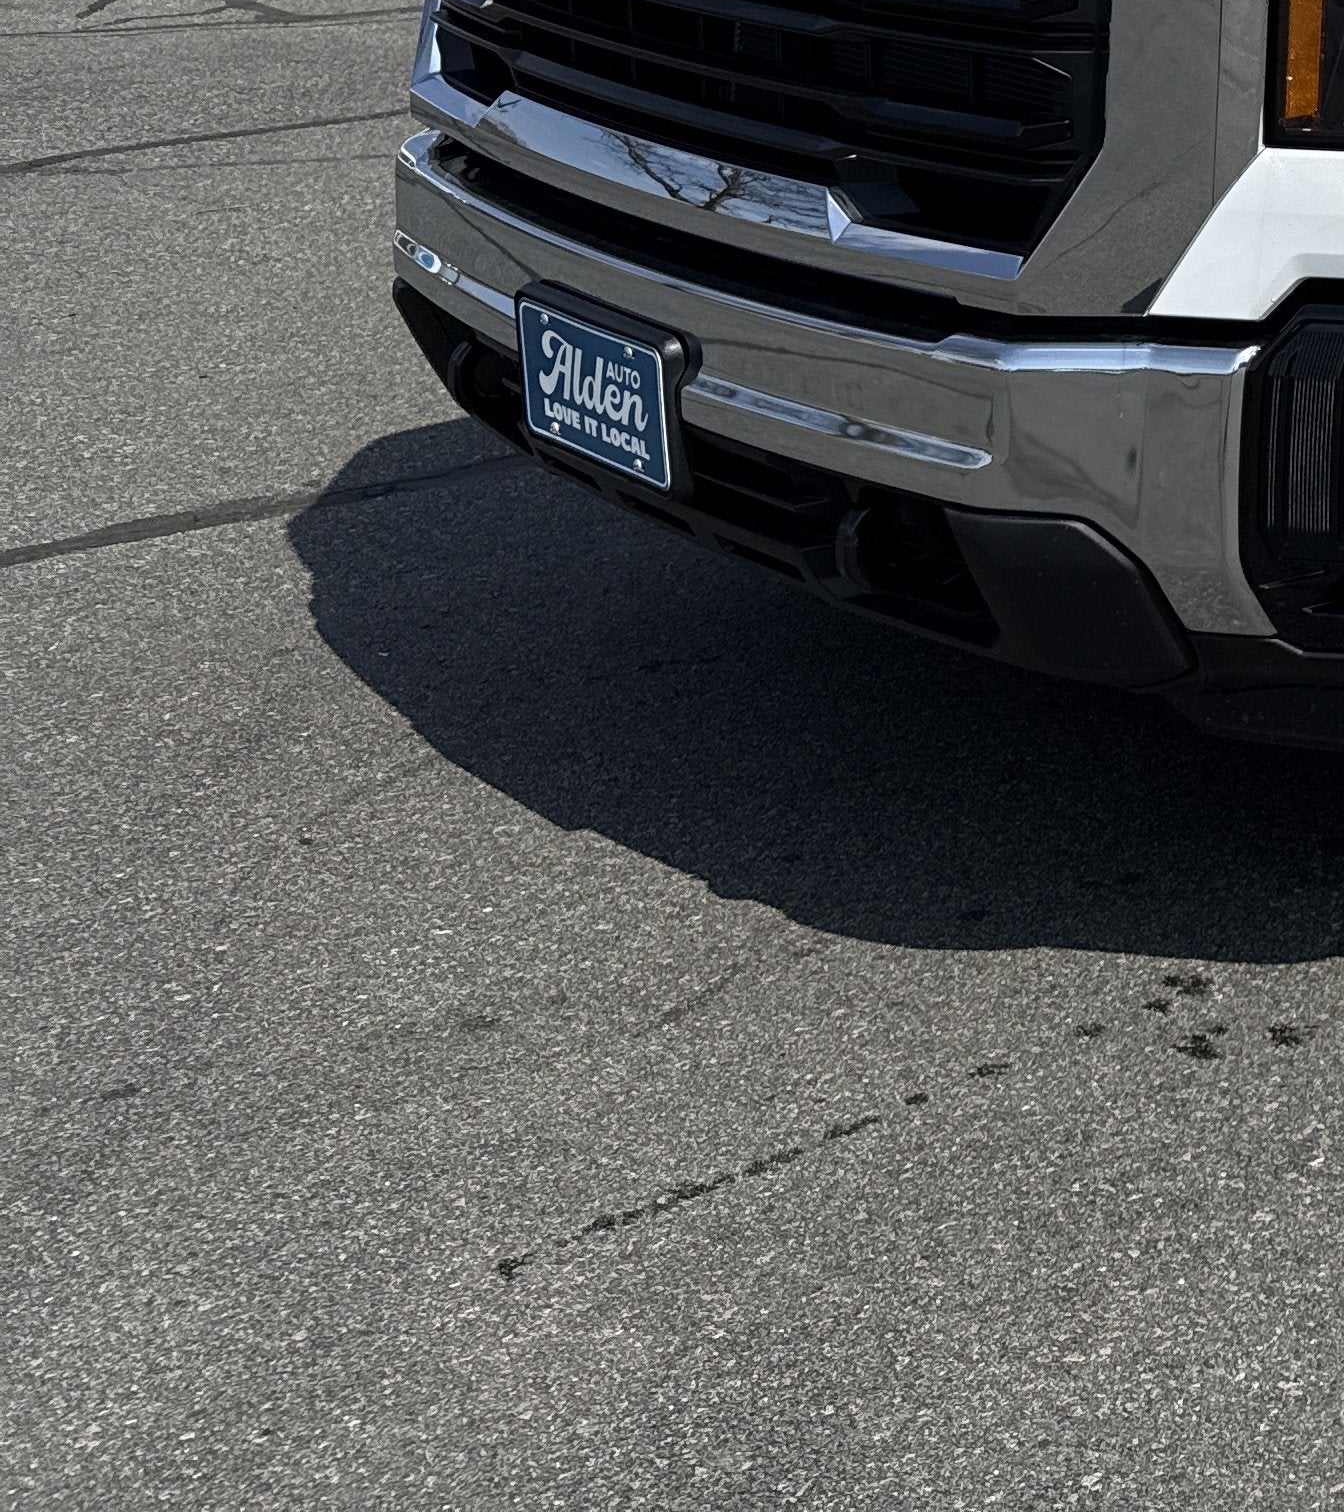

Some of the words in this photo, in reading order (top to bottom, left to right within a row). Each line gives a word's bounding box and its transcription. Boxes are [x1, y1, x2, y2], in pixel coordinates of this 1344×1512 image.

[539, 330, 648, 432] Alden
[605, 361, 641, 389] AUTO
[544, 398, 582, 431] LOVE
[584, 415, 599, 437] IT
[600, 423, 651, 461] LOCAL
